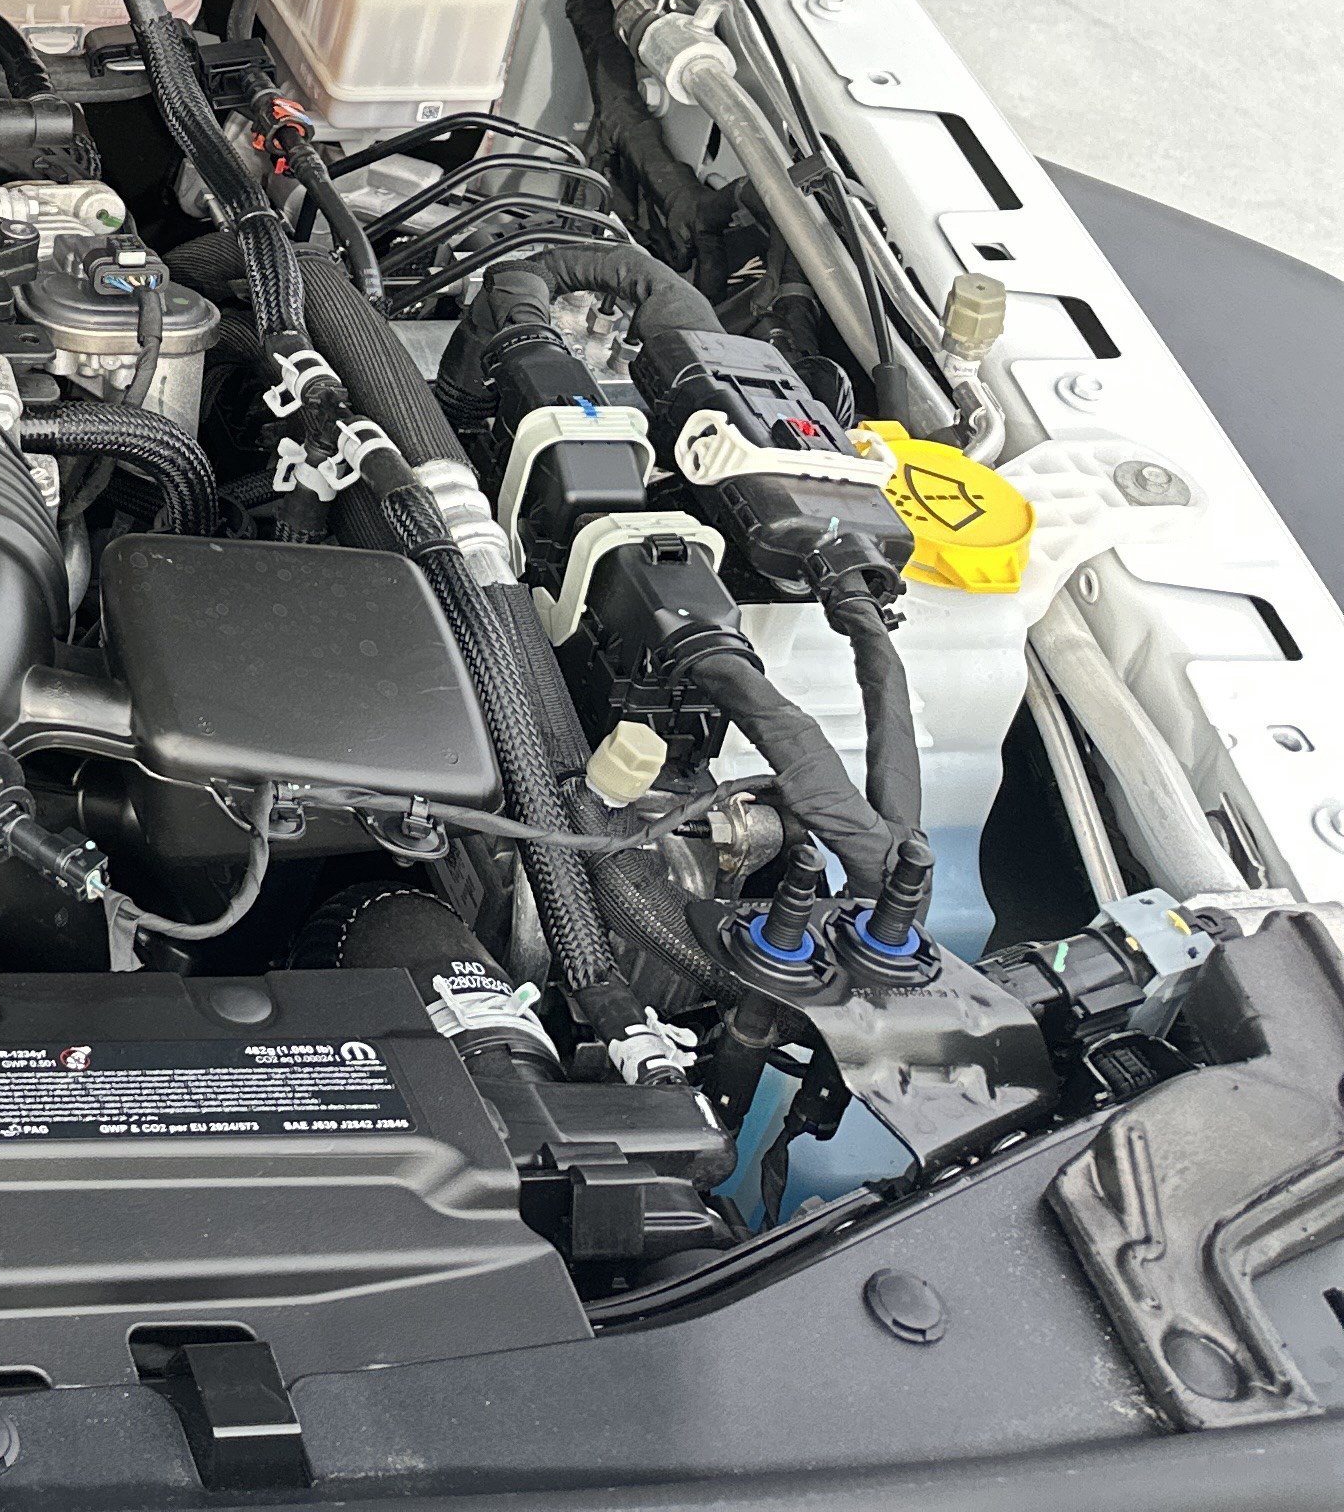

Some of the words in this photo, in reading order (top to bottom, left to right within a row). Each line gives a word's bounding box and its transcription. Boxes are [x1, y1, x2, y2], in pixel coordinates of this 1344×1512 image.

[451, 961, 486, 975] RAD
[255, 1054, 279, 1064] CO2
[23, 1124, 50, 1134] PAG
[99, 1123, 128, 1133] GWP
[141, 1123, 167, 1133] CO2
[168, 1123, 188, 1134] per
[189, 1122, 207, 1132] EU
[282, 1120, 309, 1130] SAE
